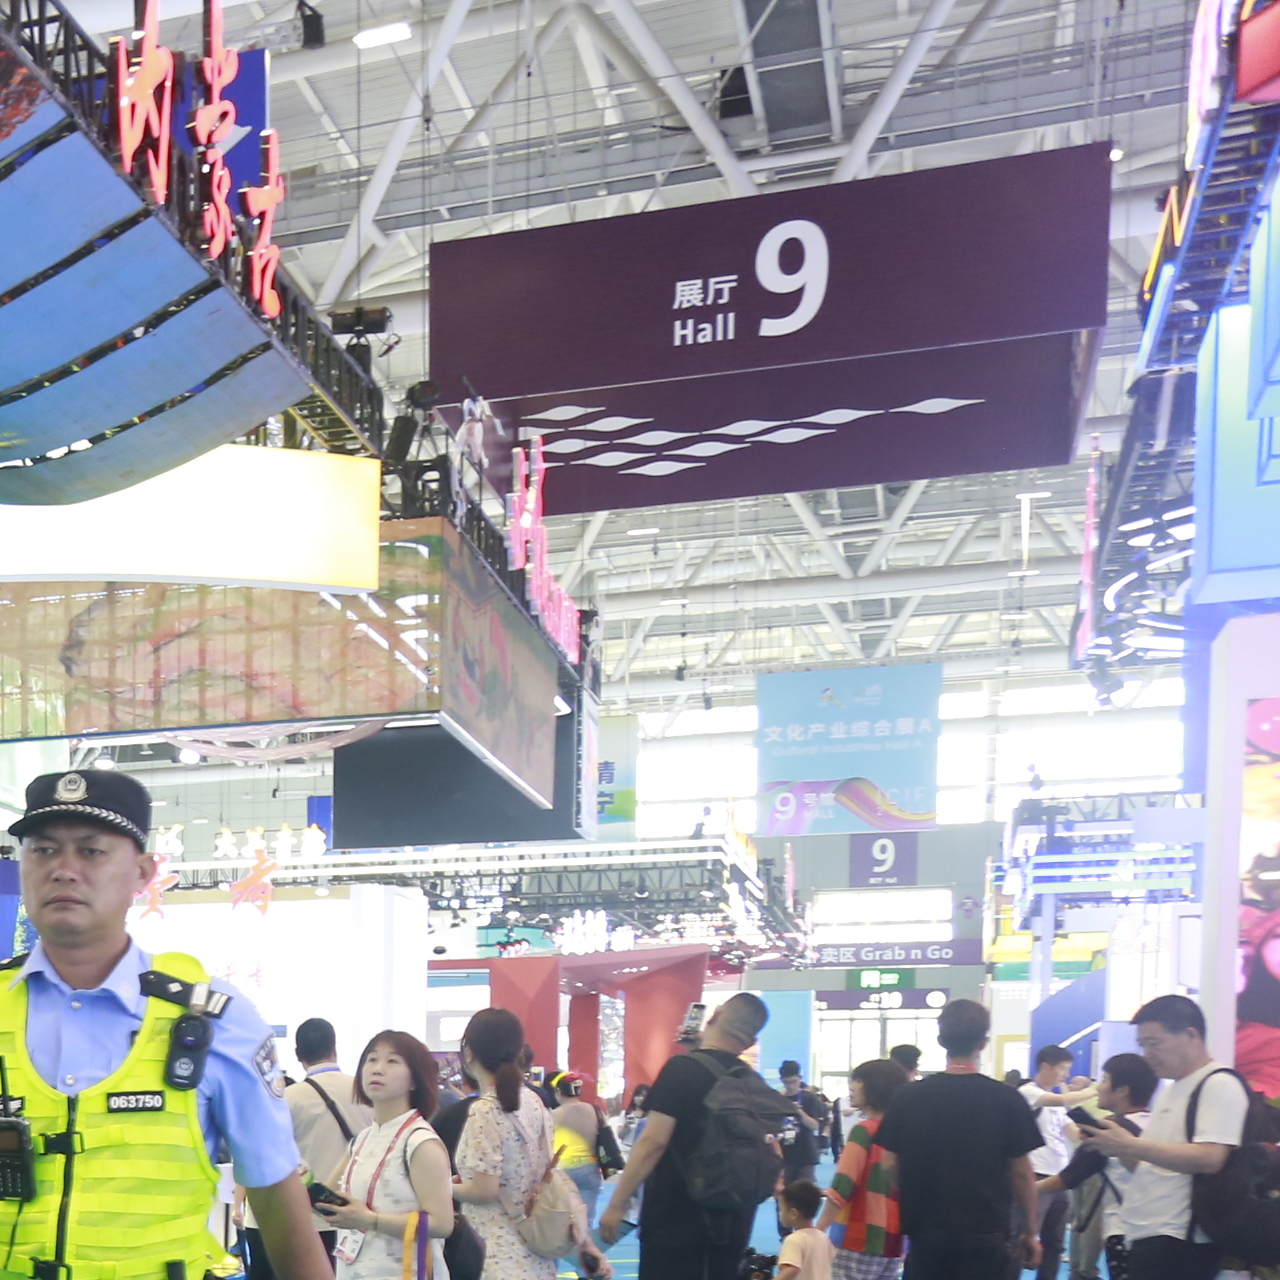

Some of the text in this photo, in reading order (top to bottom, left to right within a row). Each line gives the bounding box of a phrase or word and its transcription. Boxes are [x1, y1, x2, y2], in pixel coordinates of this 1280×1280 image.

[672, 275, 739, 310] 展厅
[755, 219, 830, 337] 9
[673, 312, 736, 347] Hall
[775, 792, 797, 820] 9
[872, 838, 895, 872] 9
[814, 945, 954, 963] 卖区 Grab n Go
[109, 1093, 164, 1110] 063750
